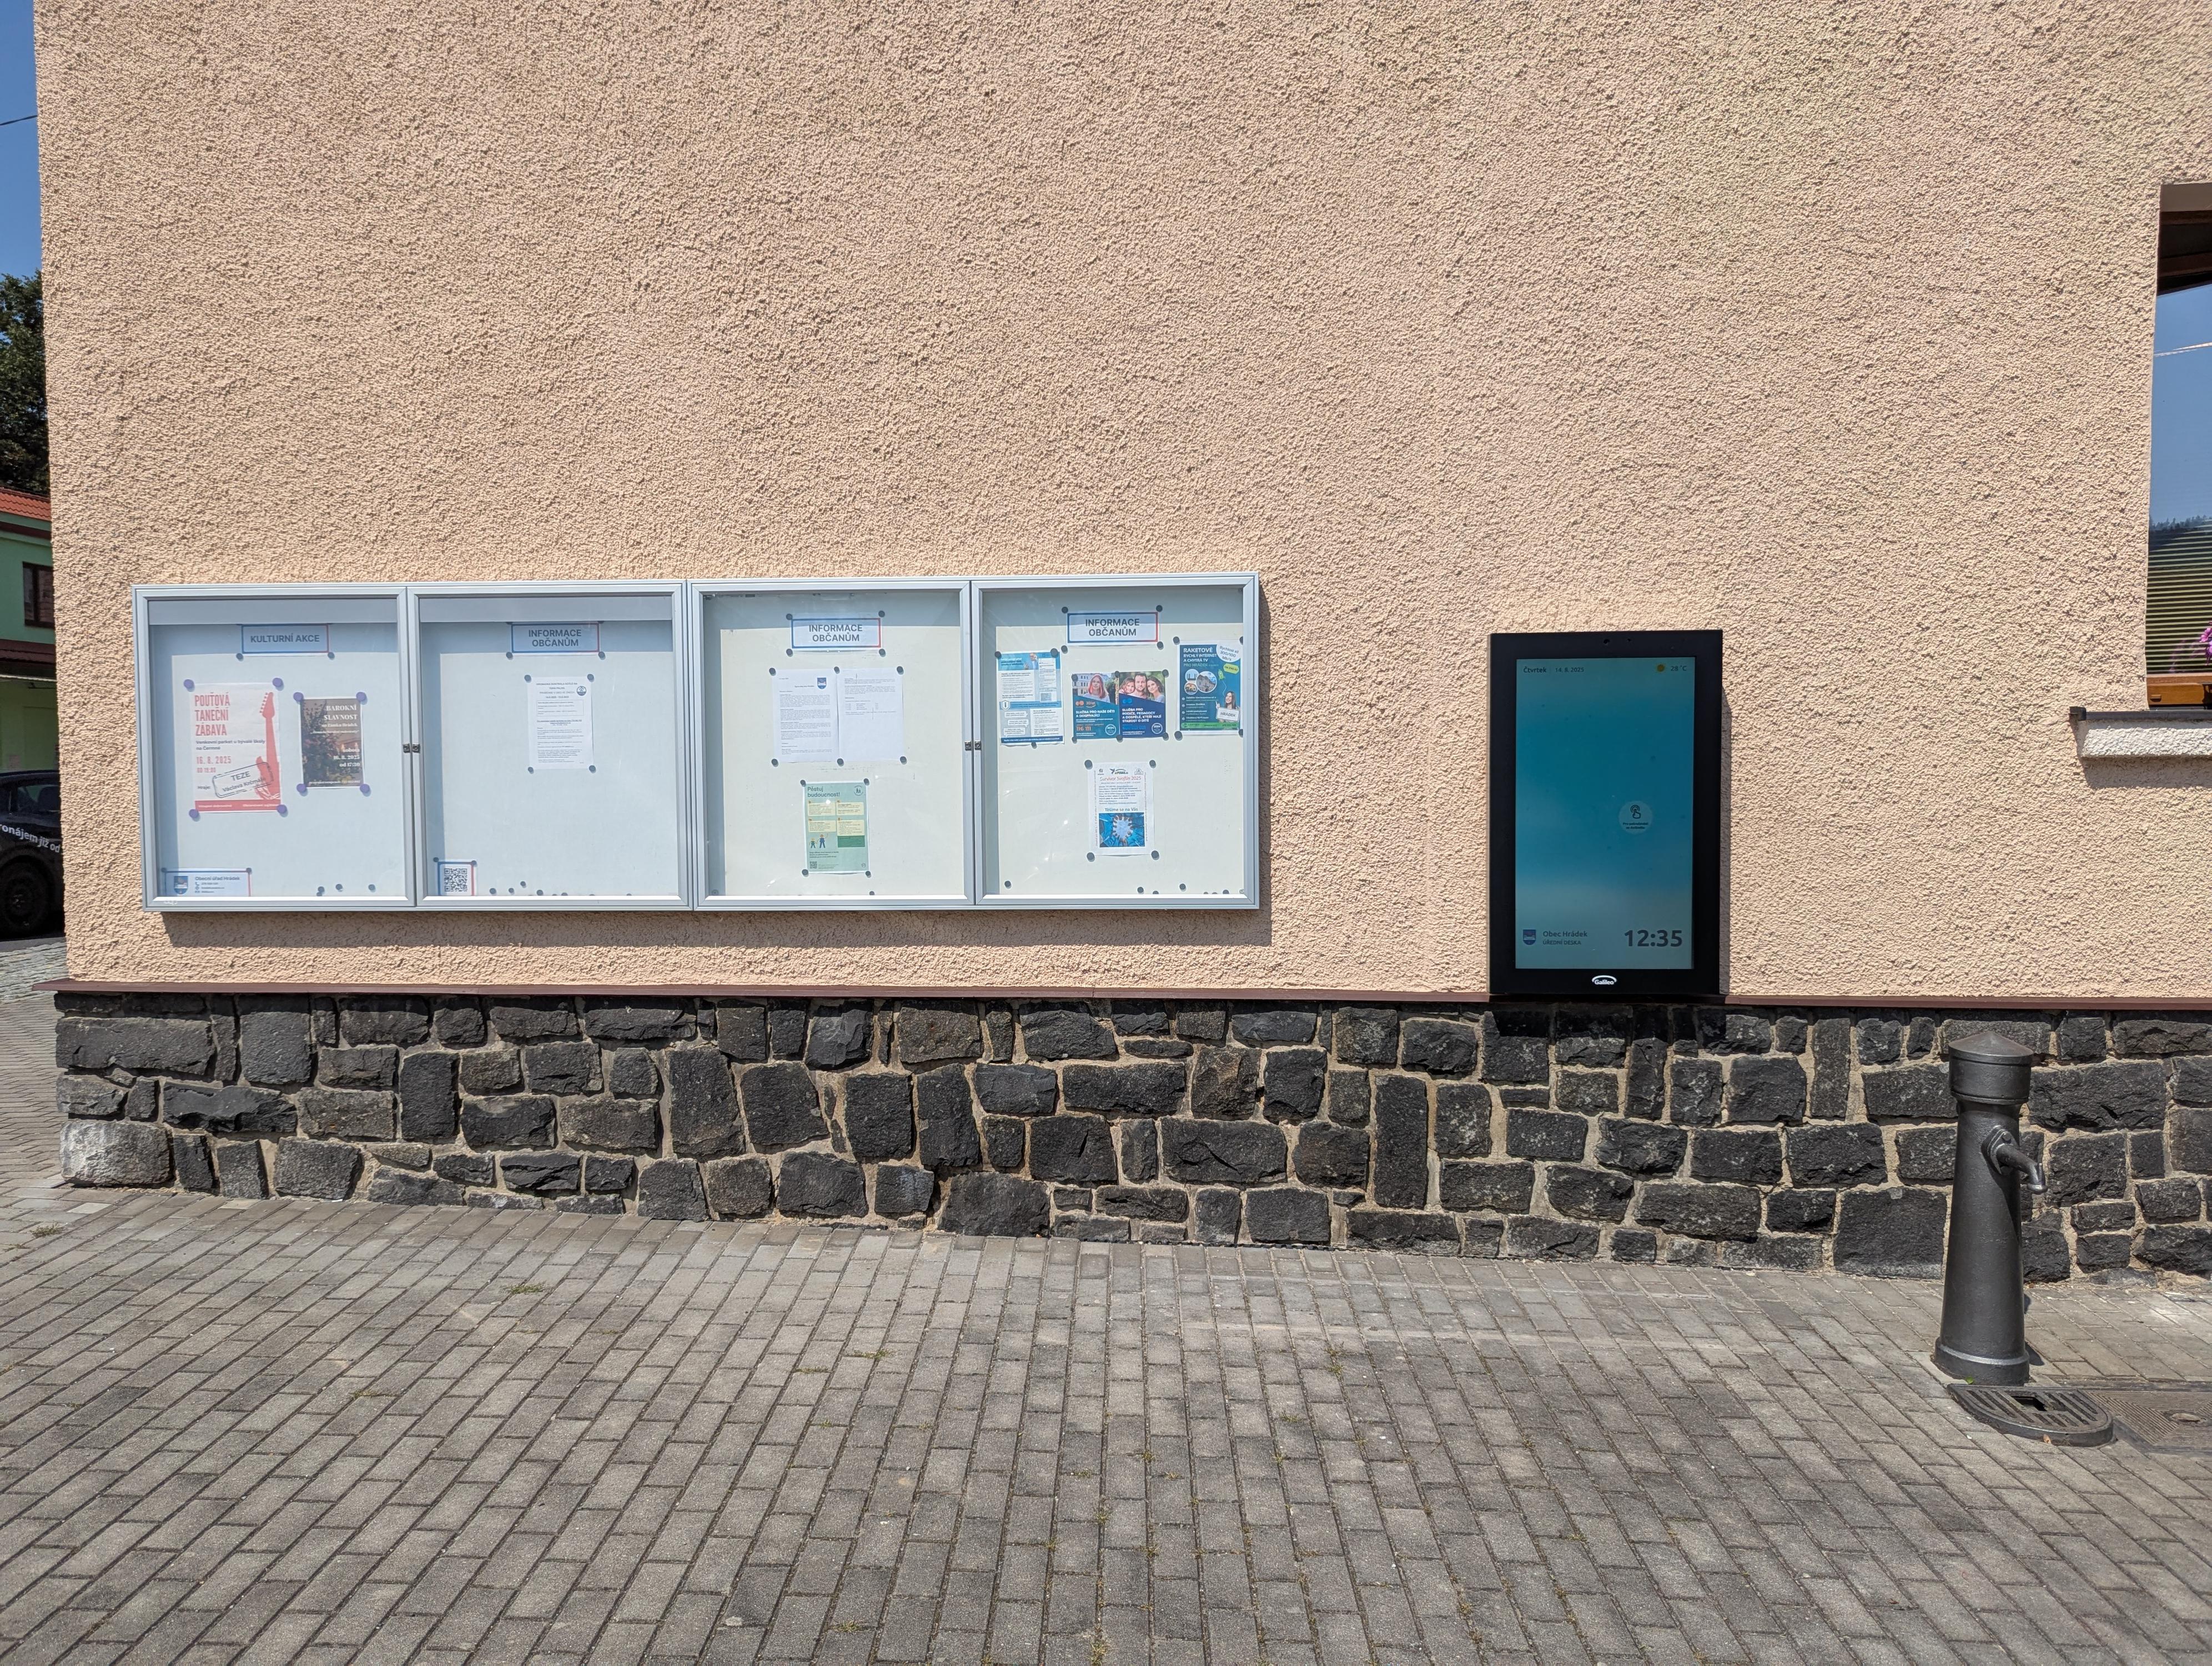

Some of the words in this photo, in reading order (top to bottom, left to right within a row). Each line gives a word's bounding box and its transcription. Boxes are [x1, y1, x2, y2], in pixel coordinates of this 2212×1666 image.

[528, 629, 582, 638] INFORMACE
[809, 624, 863, 633] INFORMACE
[1089, 626, 1137, 636] OBČANŮM
[250, 633, 294, 643] KULTURNÍ
[532, 637, 579, 647] OBČANŮM
[812, 632, 860, 642] OBČANŮM
[194, 692, 230, 706] POUŤOVÁ
[194, 707, 229, 721] TANEČNÍ
[195, 722, 227, 736] ZÁBAVA
[215, 756, 232, 764] 2025
[230, 771, 251, 781] TEZE
[50, 844, 61, 853] od
[1624, 930, 1682, 947] 12:35
